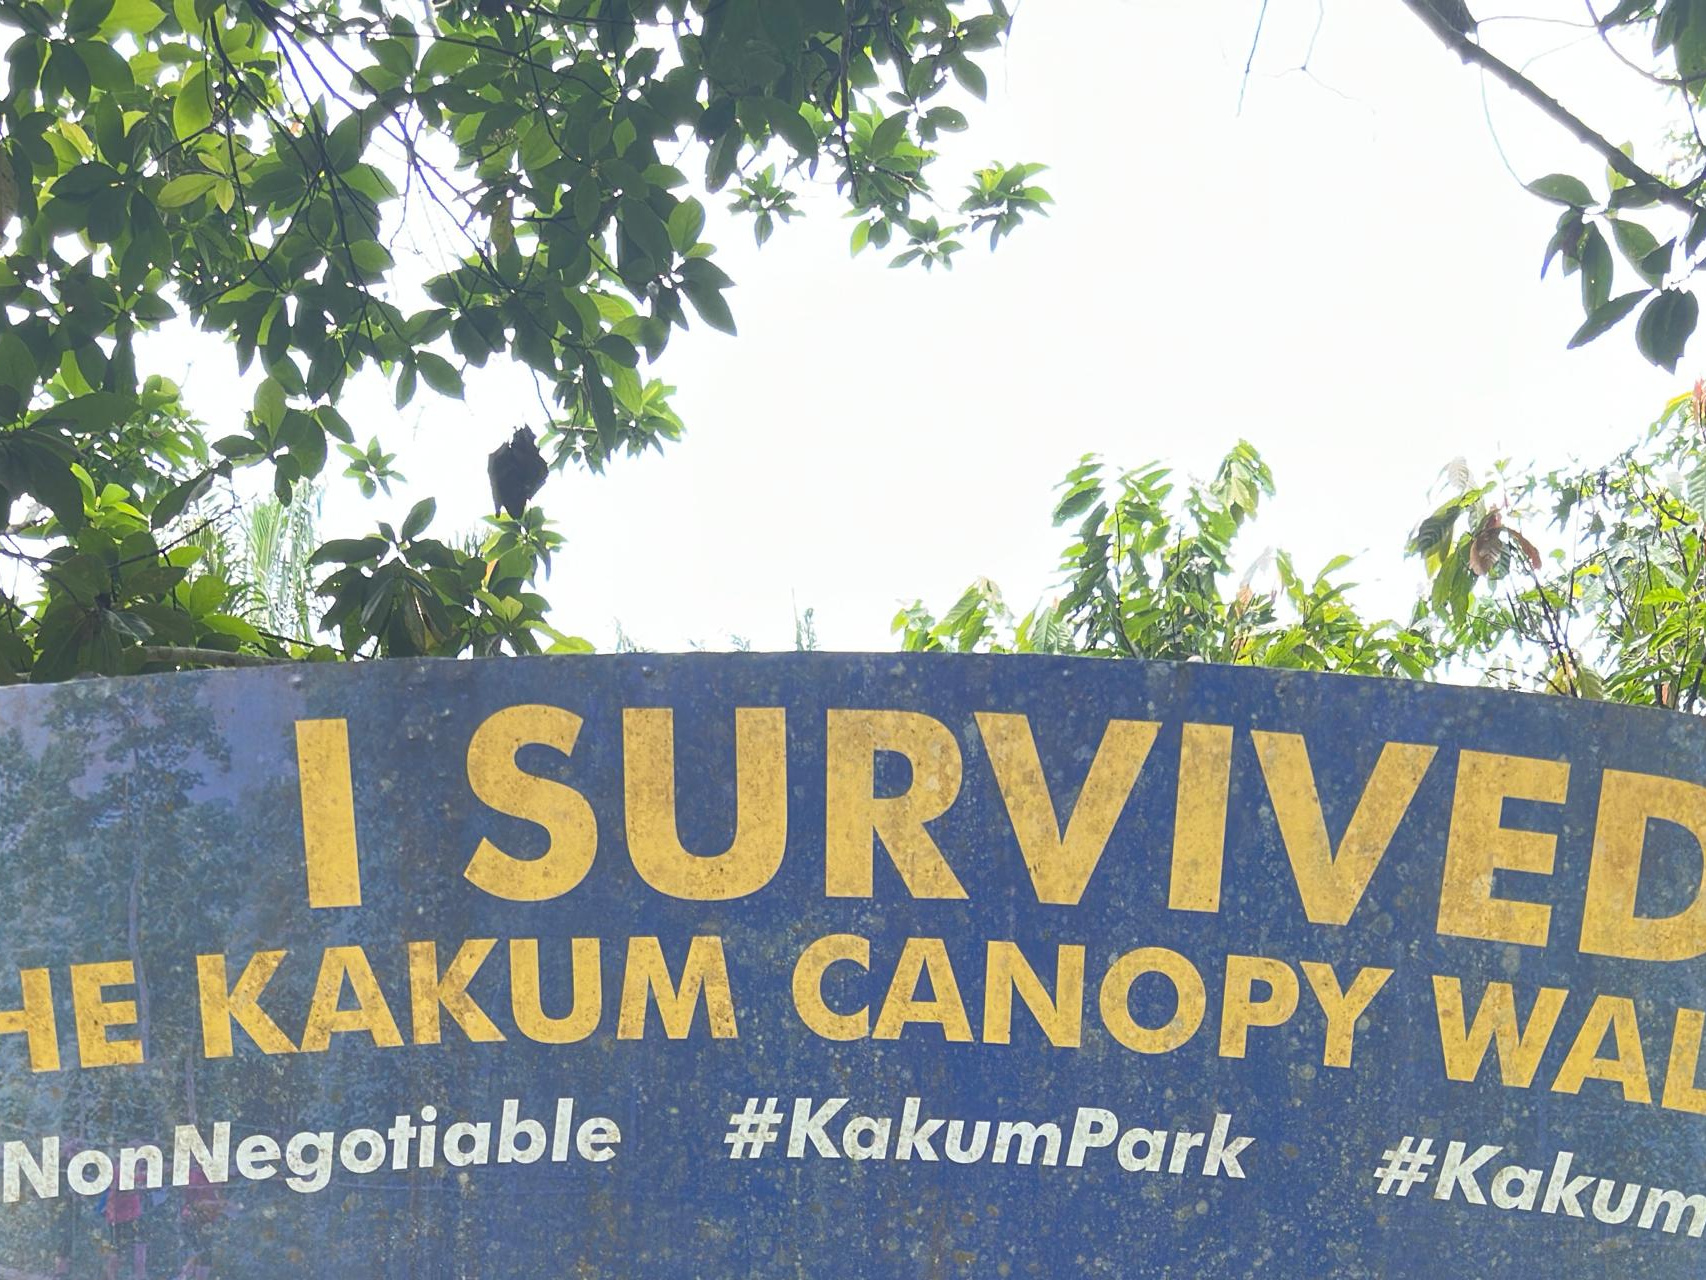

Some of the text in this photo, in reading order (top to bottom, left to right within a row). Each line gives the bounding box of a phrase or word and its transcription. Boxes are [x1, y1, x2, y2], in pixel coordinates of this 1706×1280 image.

[294, 718, 362, 909] I
[197, 936, 738, 1059] KAKUM
[792, 933, 1392, 1068] CANOPY
[724, 1096, 1255, 1179] #KakumPark
